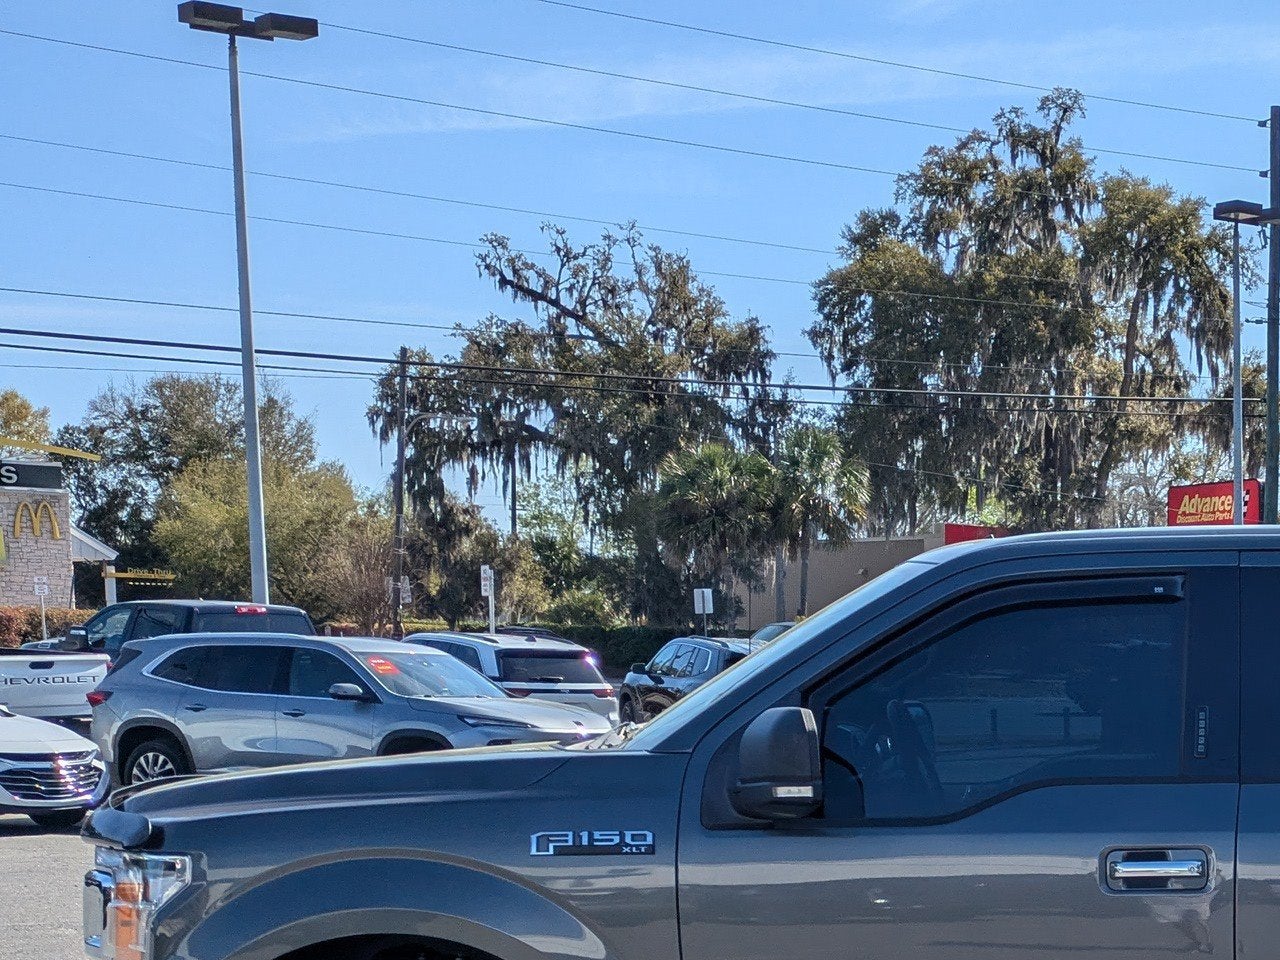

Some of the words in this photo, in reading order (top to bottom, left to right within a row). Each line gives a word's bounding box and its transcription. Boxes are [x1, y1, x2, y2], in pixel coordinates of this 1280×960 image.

[1178, 493, 1233, 514] Advance
[1176, 514, 1201, 524] Discount
[1201, 512, 1215, 522] Auto
[0, 675, 100, 685] HEVROLET
